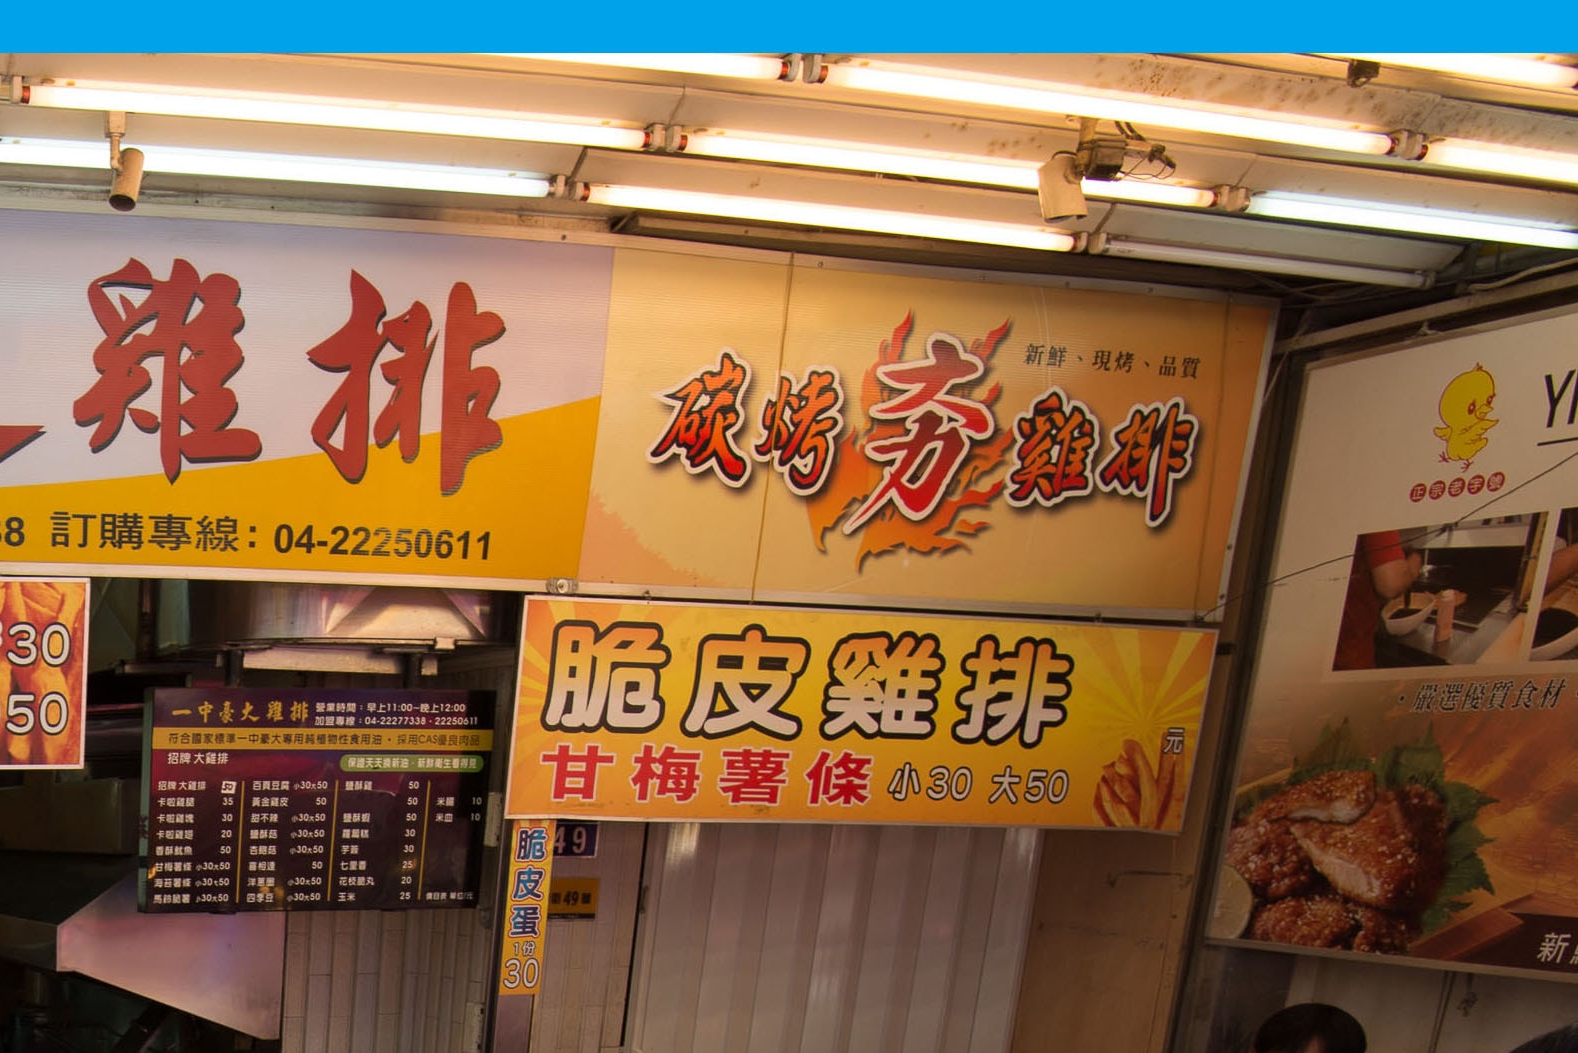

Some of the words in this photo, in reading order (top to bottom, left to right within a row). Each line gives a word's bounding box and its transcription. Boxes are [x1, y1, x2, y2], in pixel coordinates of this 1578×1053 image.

[649, 332, 1200, 536] 碳烤夯雞排
[272, 523, 492, 561] 04-22250611
[541, 619, 1074, 748] 脆皮雞排
[171, 700, 310, 724] 一中豪大雞排
[1161, 725, 1187, 755] 元
[167, 752, 191, 765] 招牌
[193, 752, 229, 765] 大雞排
[541, 741, 874, 806] 甘梅薯條
[887, 761, 973, 803] 小30
[988, 763, 1071, 803] 大50
[408, 781, 420, 790] 50
[222, 797, 234, 806] 35
[315, 797, 327, 806] 50
[407, 797, 419, 806] 50
[221, 813, 233, 822] 30
[406, 813, 417, 822] 50
[221, 830, 233, 838] 20
[404, 829, 416, 838] 30
[220, 846, 232, 855] 50
[403, 845, 415, 853] 30
[311, 861, 323, 870] 50
[400, 877, 412, 885] 20
[508, 827, 548, 938] 脆皮蛋
[399, 892, 411, 901] 25
[1536, 932, 1578, 965] 新
[503, 957, 540, 989] 30
